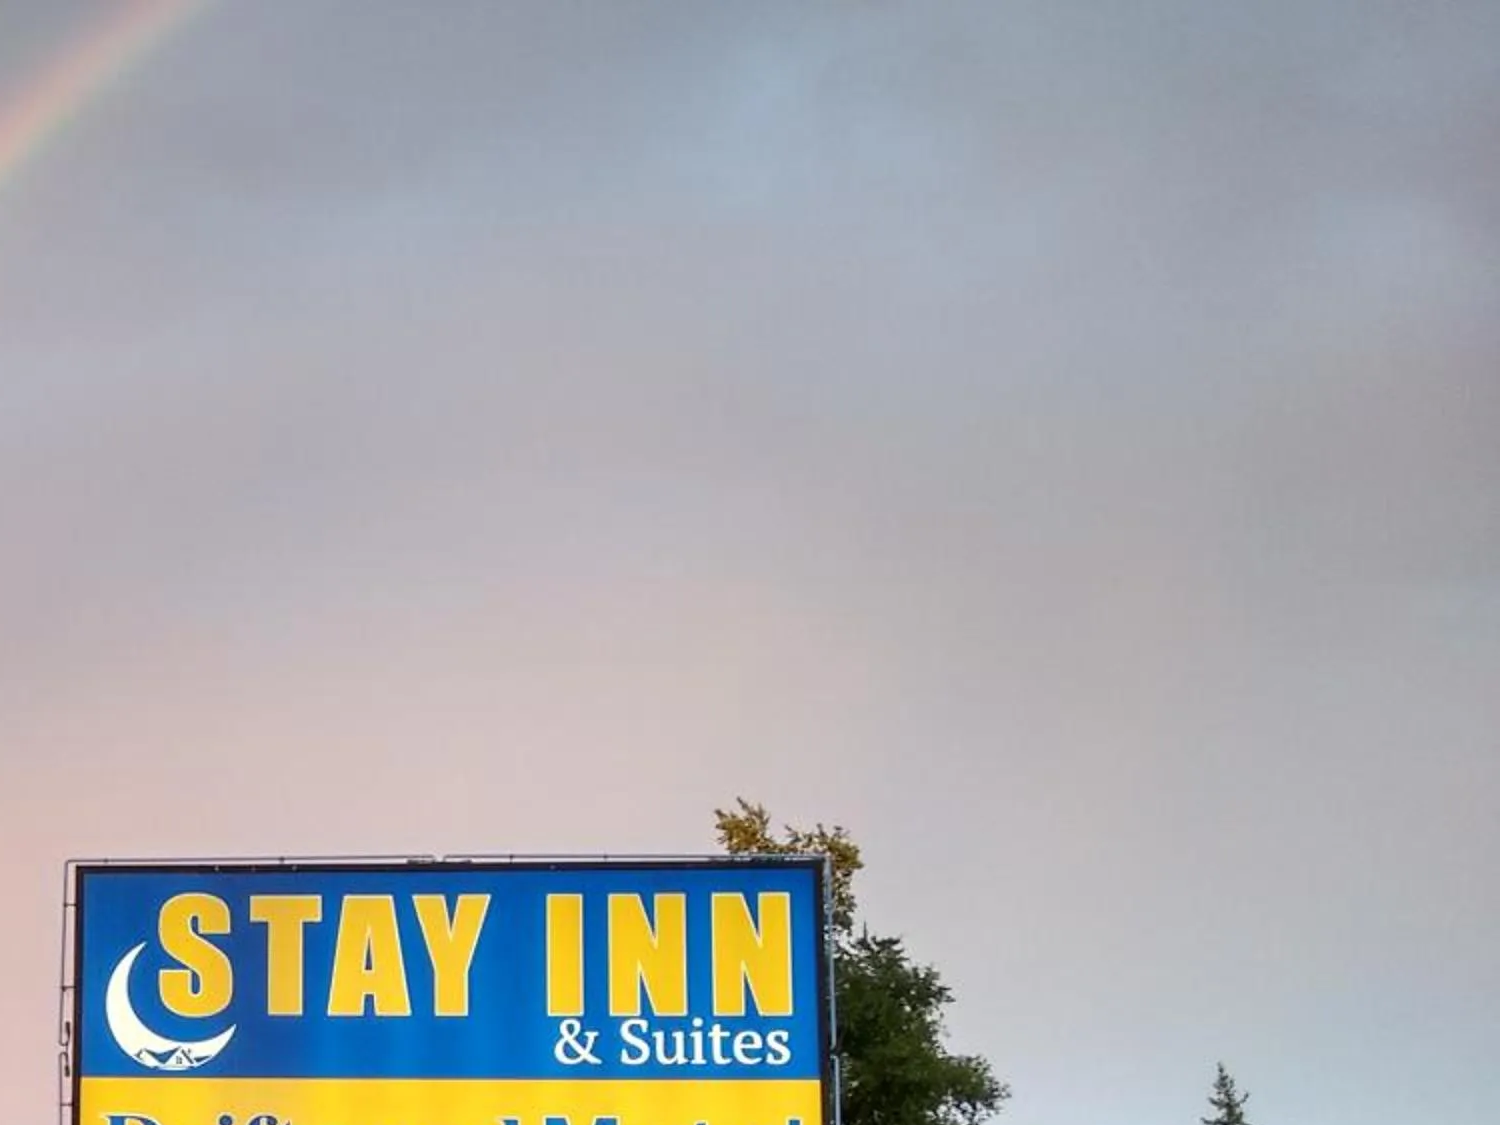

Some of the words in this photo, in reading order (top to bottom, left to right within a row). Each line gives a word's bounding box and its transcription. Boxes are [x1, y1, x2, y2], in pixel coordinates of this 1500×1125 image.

[157, 893, 491, 1018] STAY
[545, 892, 793, 1017] INN
[553, 1019, 601, 1065] &
[619, 1018, 791, 1066] Suites
